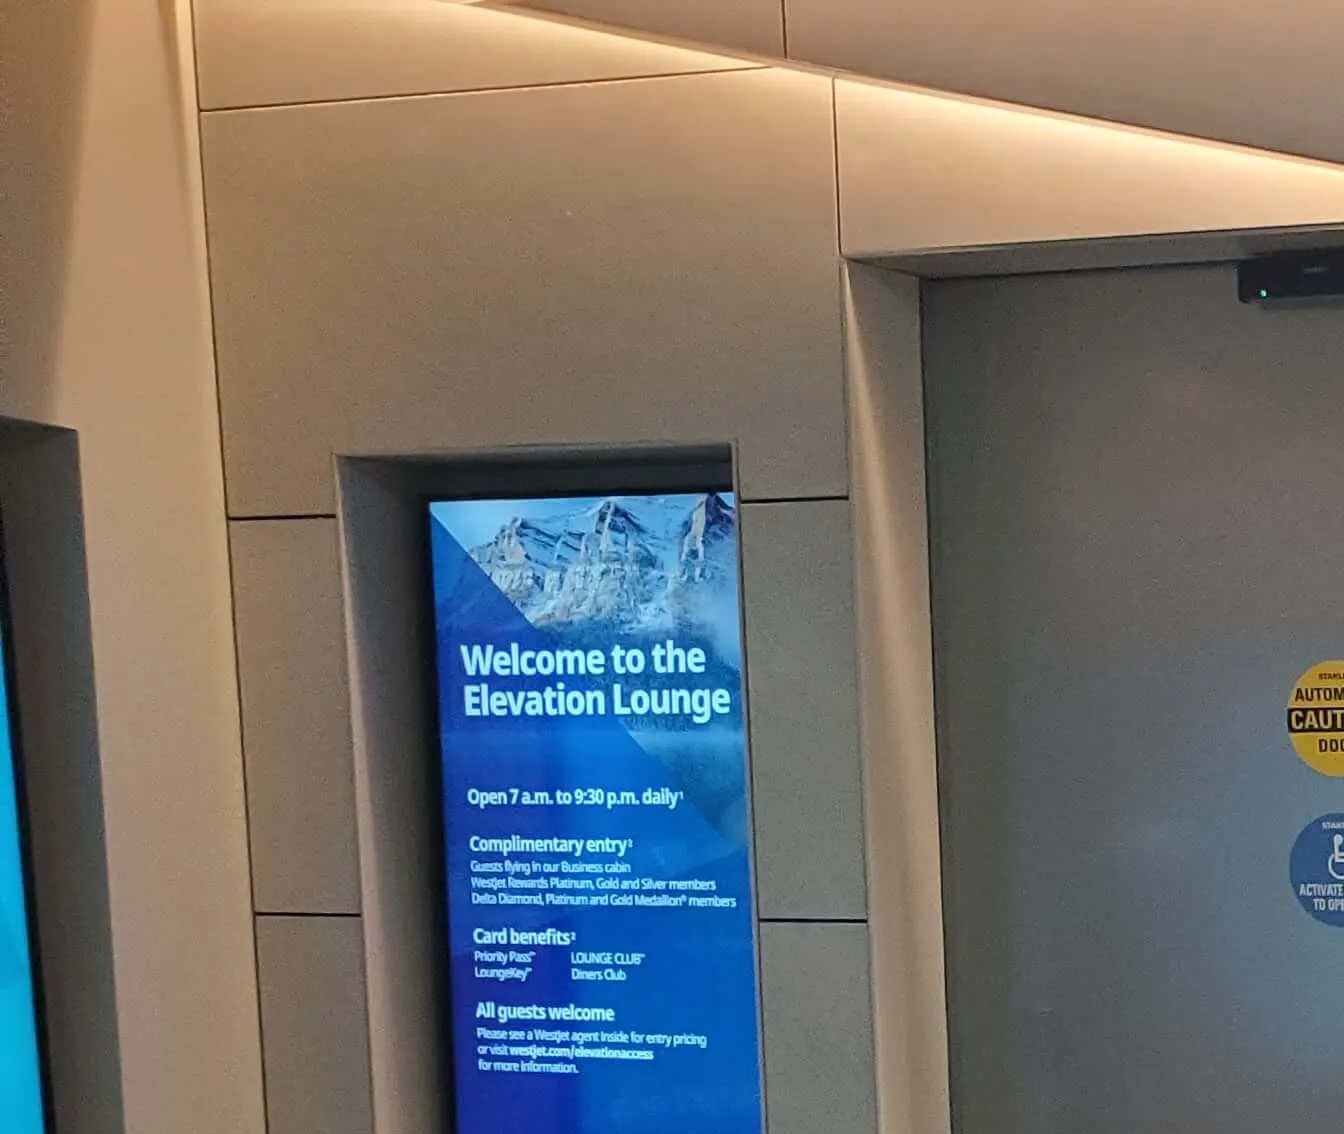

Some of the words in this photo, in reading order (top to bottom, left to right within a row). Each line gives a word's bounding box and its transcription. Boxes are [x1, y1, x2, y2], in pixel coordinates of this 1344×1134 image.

[460, 643, 605, 676] Welcome
[611, 644, 646, 675] to
[652, 640, 706, 674] the
[463, 682, 606, 716] Elevation
[613, 684, 732, 723] Lounge
[467, 788, 508, 809] Open
[509, 788, 520, 805] 7
[521, 791, 555, 805] a.m.
[555, 789, 573, 805] to
[574, 788, 605, 805] 9:30
[606, 791, 640, 809] p.m.
[469, 835, 585, 857] Complimentary
[470, 860, 504, 873] Guests
[504, 859, 531, 876] flying
[532, 861, 542, 873] in
[543, 863, 560, 873] our
[561, 860, 603, 873] Business
[604, 861, 632, 873] cabin
[507, 876, 549, 889] Rewards
[596, 877, 619, 890] Gold
[620, 878, 640, 890] and
[641, 877, 667, 891] Silver
[668, 879, 716, 892] members
[1299, 883, 1344, 898] ACTIVATE
[471, 892, 497, 905] Delta
[498, 892, 545, 907] Diamond,
[545, 892, 588, 905] Platinum
[589, 893, 609, 906] and
[610, 894, 633, 907] Gold
[688, 895, 737, 908] members
[1313, 898, 1327, 912] TO
[473, 928, 508, 945] Card
[474, 951, 508, 966] Priority
[570, 952, 613, 965] LOUNGE
[571, 968, 603, 981] Diners
[603, 969, 627, 981] Club
[476, 1001, 496, 1019] All
[497, 1004, 547, 1024] guests
[547, 1003, 616, 1022] welcome
[477, 1027, 508, 1040] Please
[508, 1030, 526, 1040] see
[526, 1030, 533, 1039] a
[571, 1031, 600, 1045] agent
[600, 1030, 630, 1043] inside
[630, 1031, 645, 1044] for
[645, 1033, 673, 1048] entry
[673, 1033, 708, 1049] pricing
[477, 1045, 490, 1055] or
[490, 1043, 508, 1056] visit
[478, 1058, 493, 1071] for
[493, 1061, 520, 1072] more
